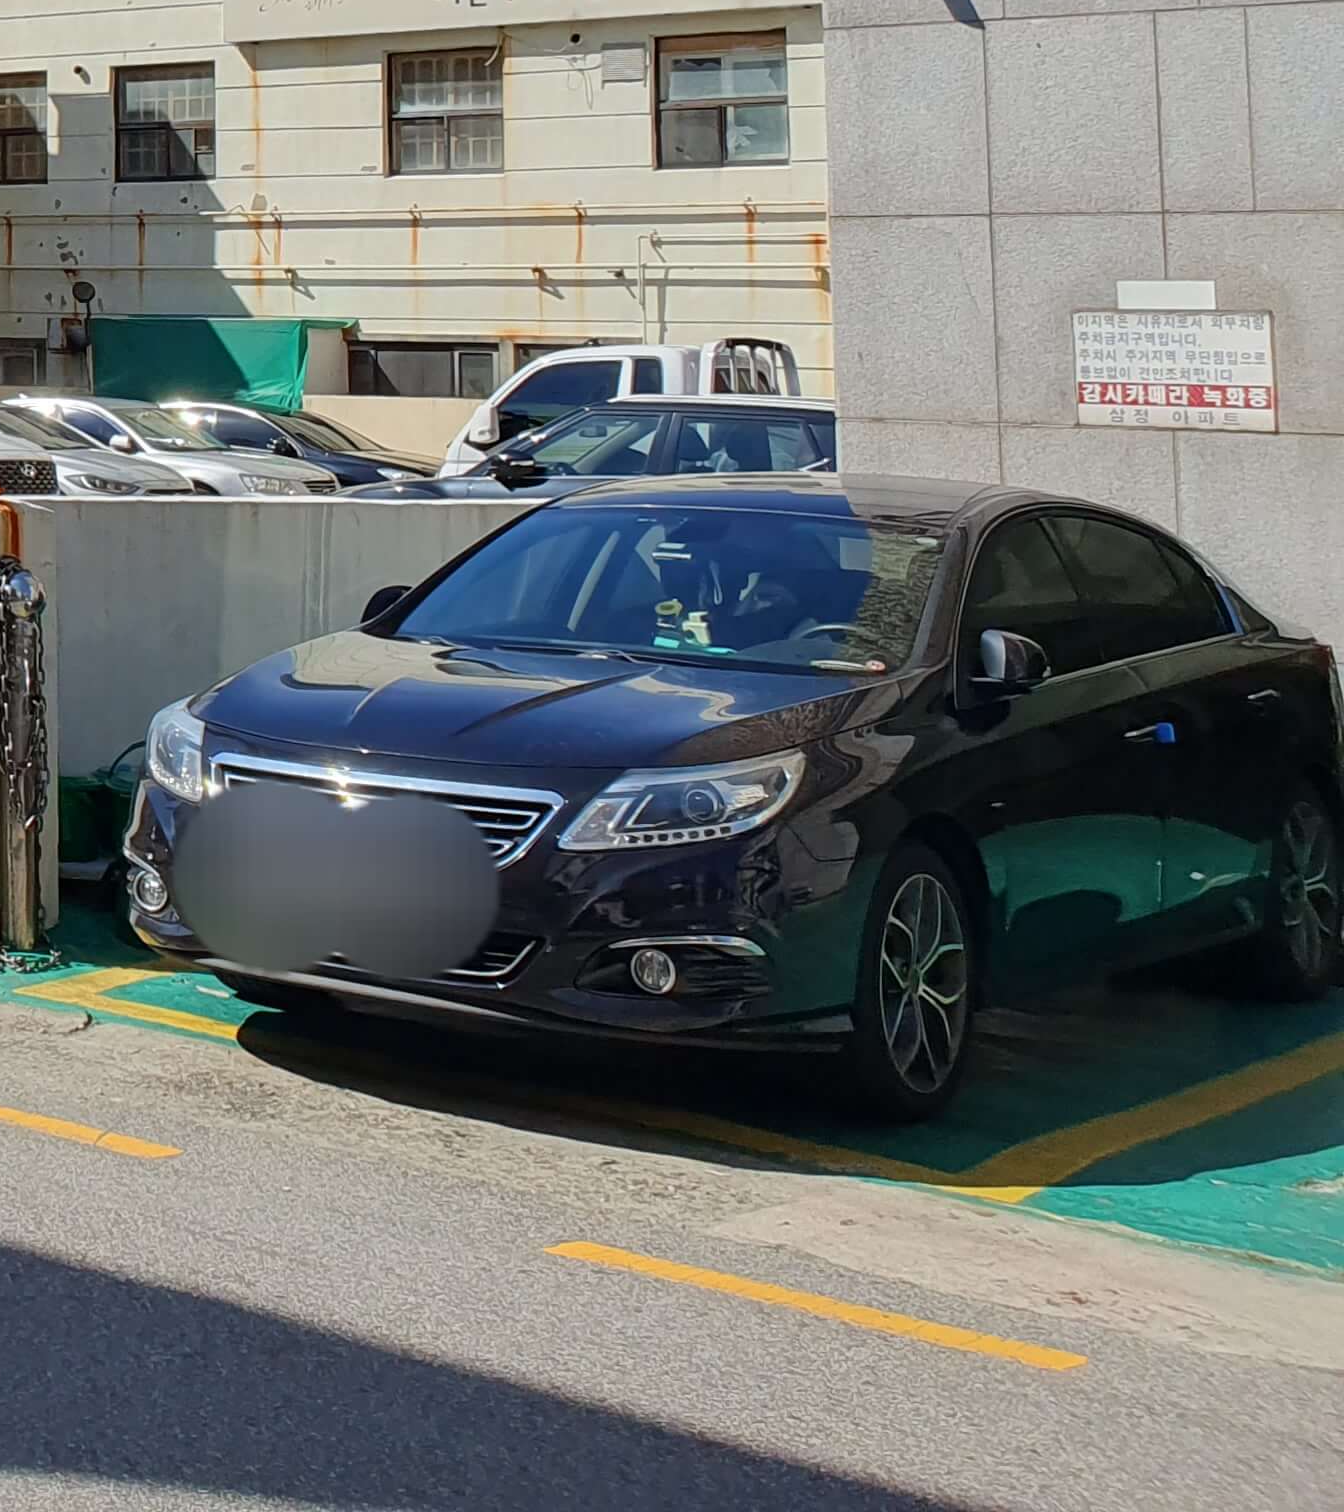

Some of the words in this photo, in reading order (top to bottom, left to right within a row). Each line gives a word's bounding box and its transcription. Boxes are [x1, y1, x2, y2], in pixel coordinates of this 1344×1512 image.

[1081, 383, 1190, 406] 감시카메라
[1202, 386, 1269, 408] 녹화중
[1172, 410, 1241, 426] 아파트
